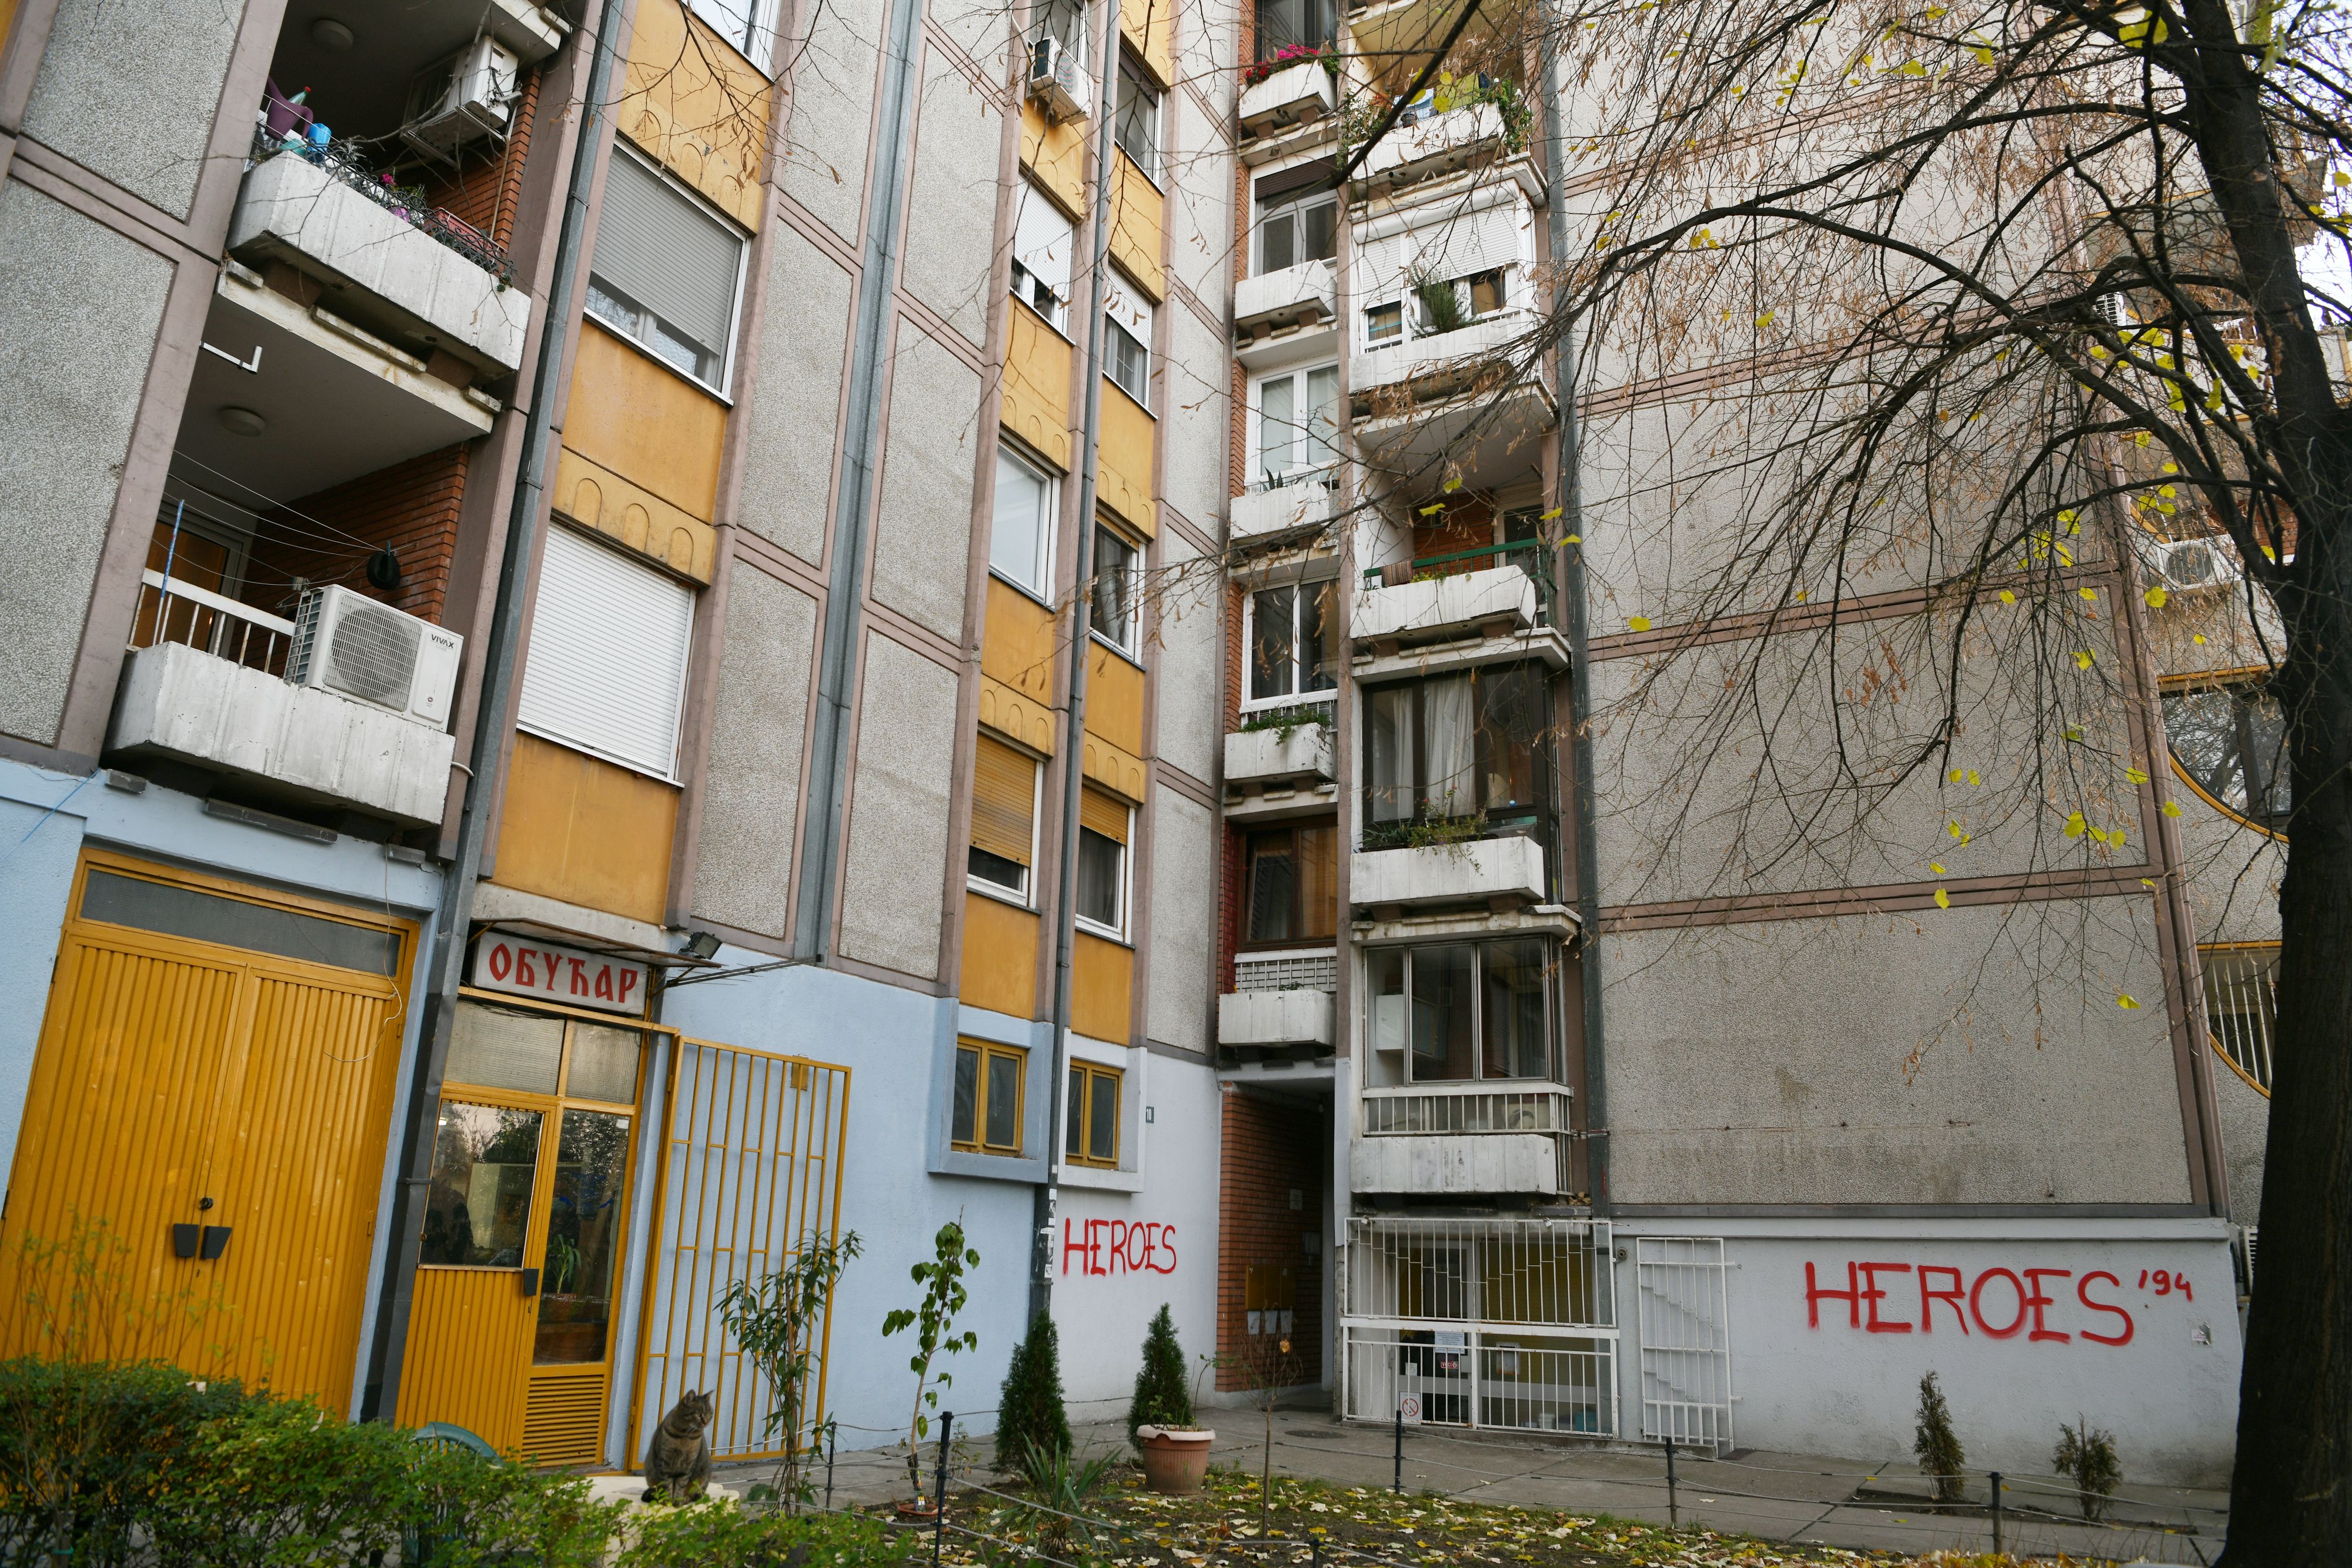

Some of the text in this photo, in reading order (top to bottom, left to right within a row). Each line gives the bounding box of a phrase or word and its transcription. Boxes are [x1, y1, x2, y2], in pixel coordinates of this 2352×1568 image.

[431, 634, 455, 648] VIVAX
[489, 943, 638, 1003] ОБУЋАР
[1146, 1108, 1152, 1121] 10
[1063, 1218, 1177, 1277] HEROES
[1805, 1261, 2193, 1346] HEROES '94
